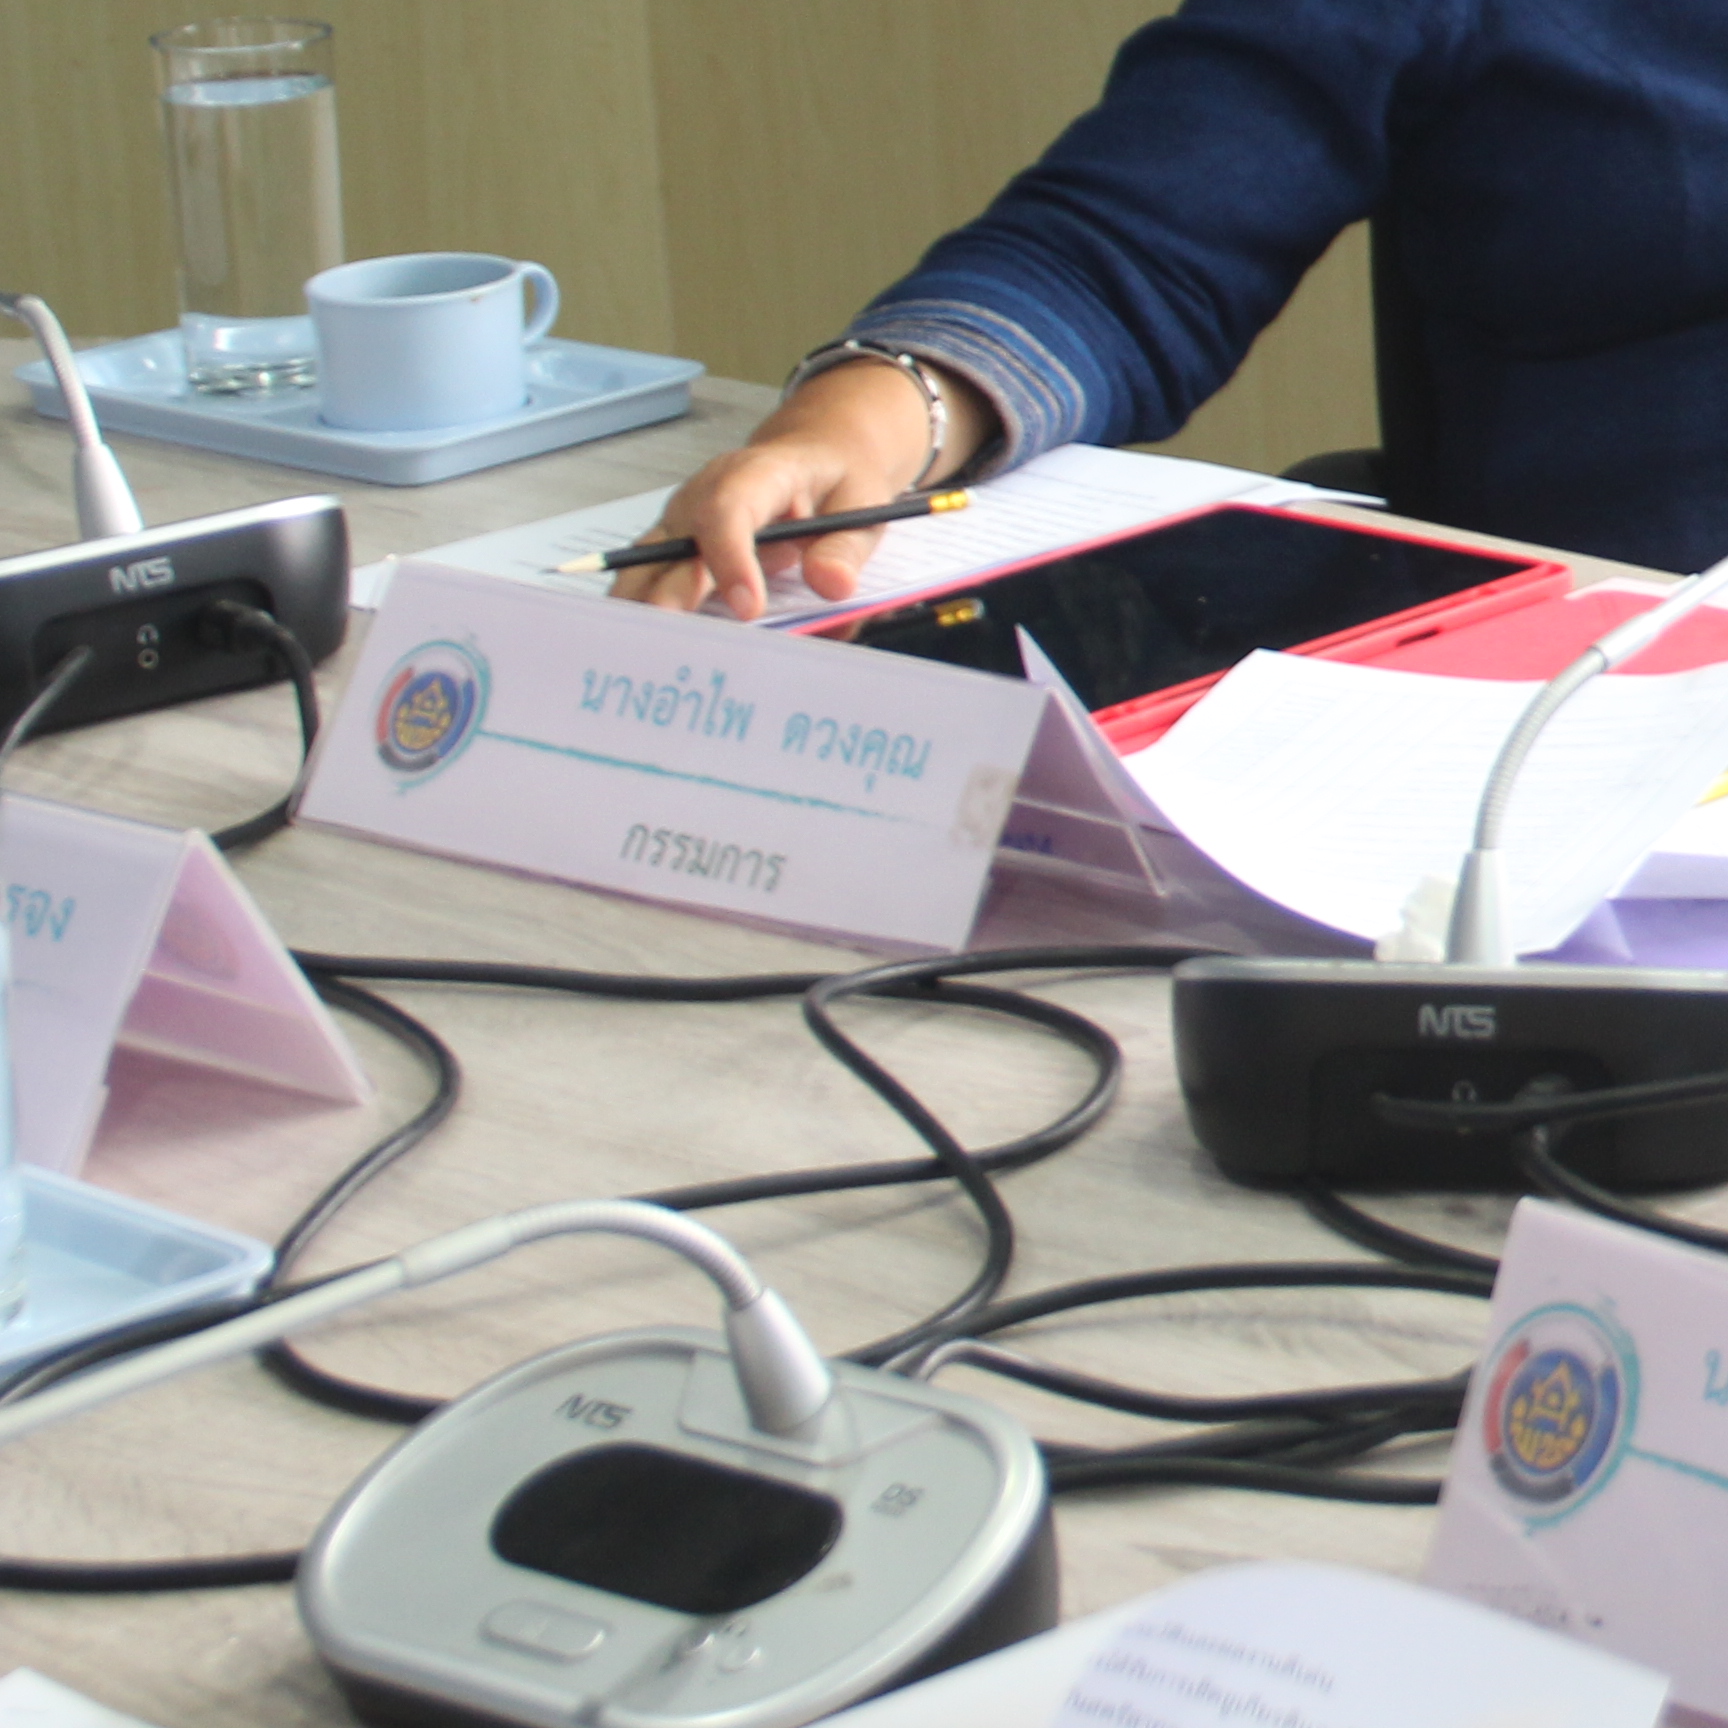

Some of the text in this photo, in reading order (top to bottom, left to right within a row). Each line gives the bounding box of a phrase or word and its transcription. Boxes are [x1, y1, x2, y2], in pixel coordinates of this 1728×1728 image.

[579, 665, 755, 742] นางอำไพ
[619, 822, 787, 893] กรรมการ
